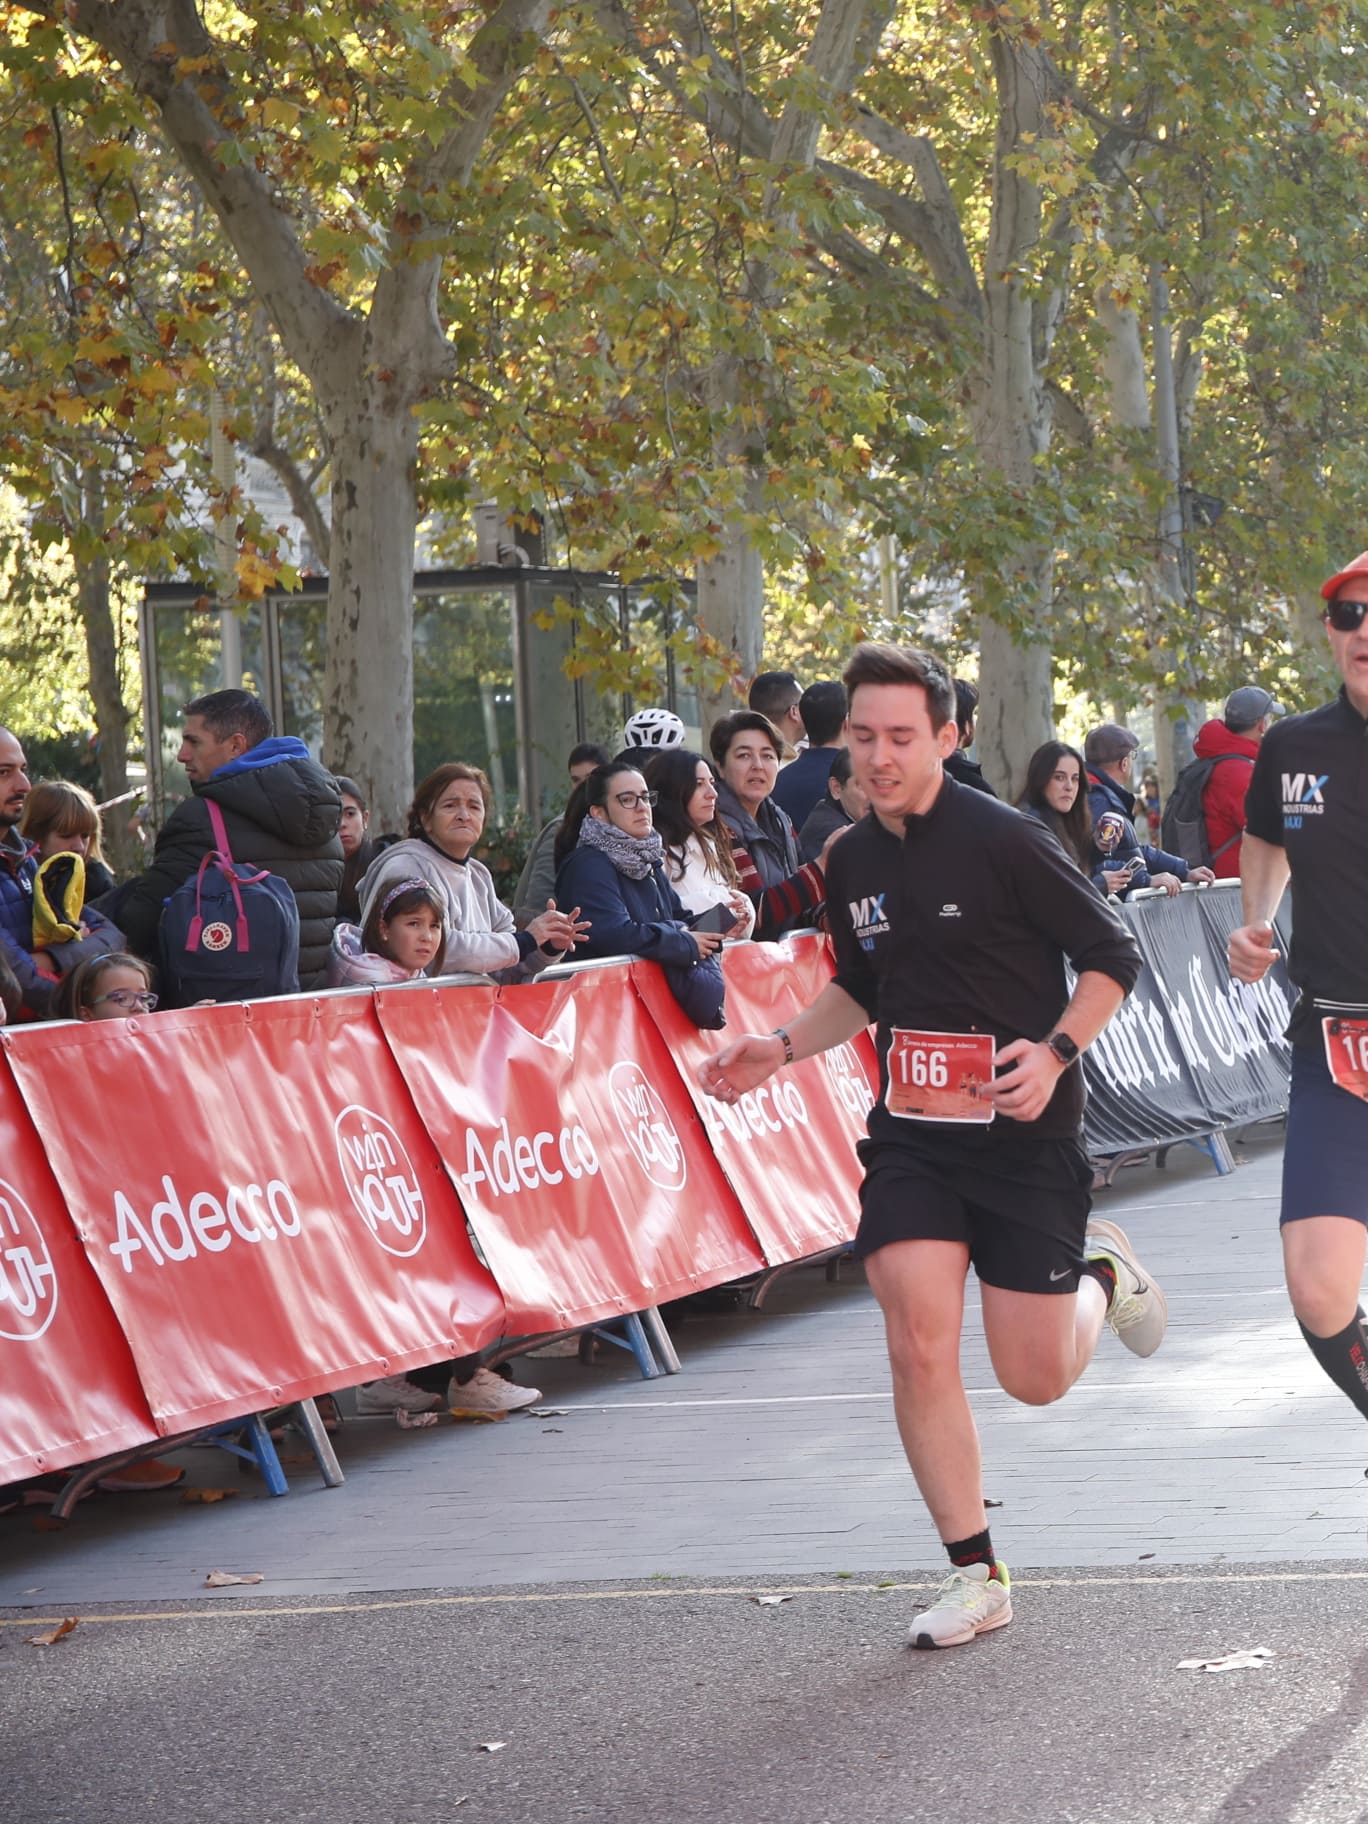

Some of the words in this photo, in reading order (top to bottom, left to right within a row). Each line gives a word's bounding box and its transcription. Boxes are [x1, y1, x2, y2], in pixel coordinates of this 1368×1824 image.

[1281, 772, 1330, 803] MX
[848, 893, 888, 930] MX
[898, 1047, 948, 1088] 166
[461, 1116, 600, 1201] Adecco
[108, 1174, 301, 1273] Adecco
